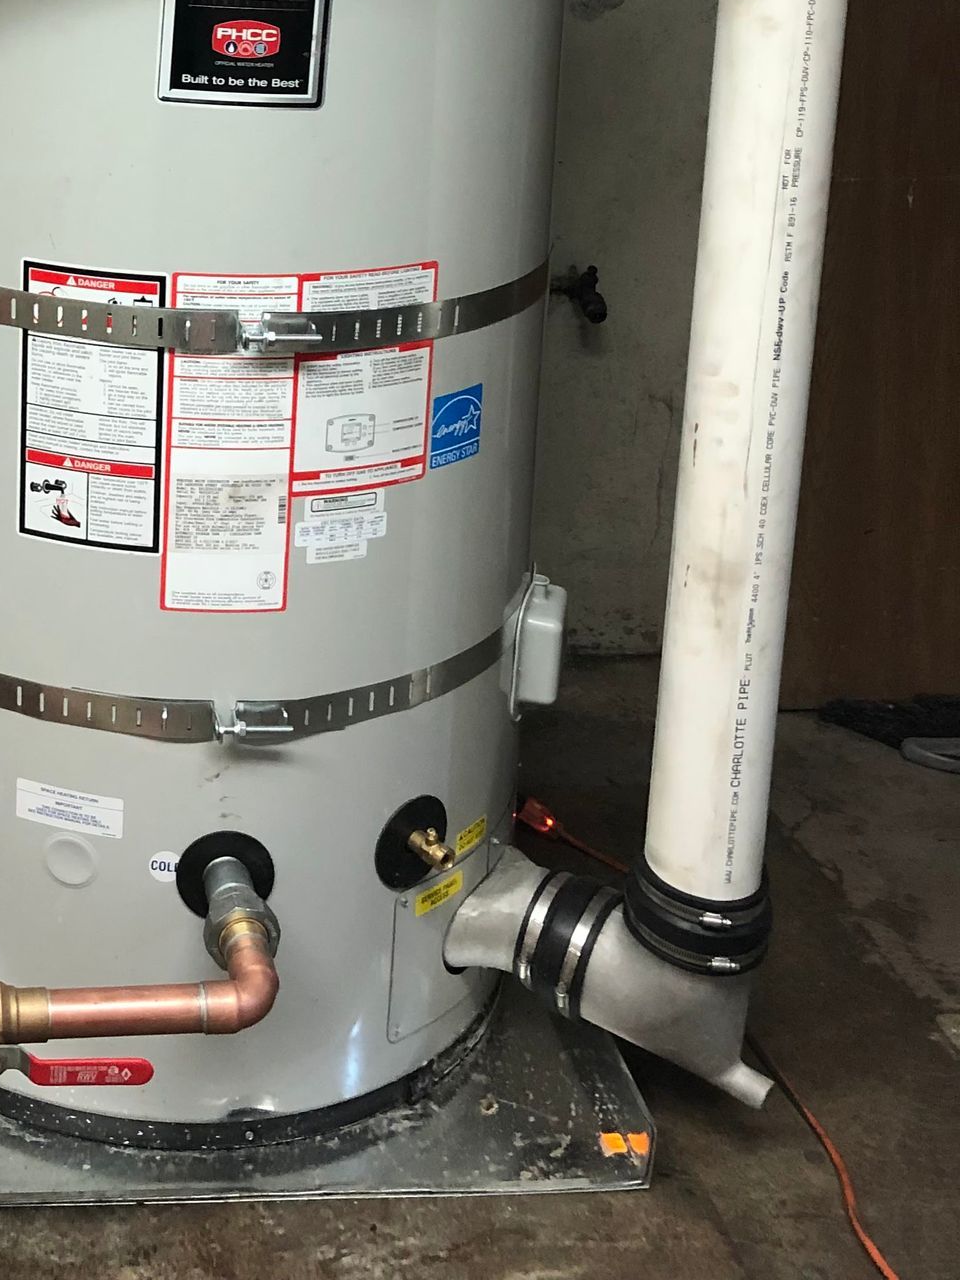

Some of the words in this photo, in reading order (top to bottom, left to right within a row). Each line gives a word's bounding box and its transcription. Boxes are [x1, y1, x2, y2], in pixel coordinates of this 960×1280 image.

[216, 27, 278, 41] PHCC
[182, 74, 209, 84] Built
[213, 75, 225, 86] to
[228, 76, 244, 87] be
[248, 77, 268, 88] the
[783, 148, 791, 165] FOR
[790, 148, 802, 188] PRESSURE
[781, 174, 789, 190] NOT
[787, 196, 798, 227] 891-16
[784, 241, 792, 262] ASTM
[77, 278, 115, 290] DANGER
[779, 270, 789, 293] Code
[771, 367, 781, 388] PIPE
[765, 431, 775, 450] CORE
[432, 449, 459, 467] ENERGY
[460, 442, 478, 457] STAR
[74, 460, 112, 472] DANGER
[761, 453, 772, 492] CELLULAR
[758, 518, 766, 529] 40
[751, 583, 760, 603] 4400
[737, 679, 750, 710] PIPE
[730, 718, 747, 788] CHARLOTTE
